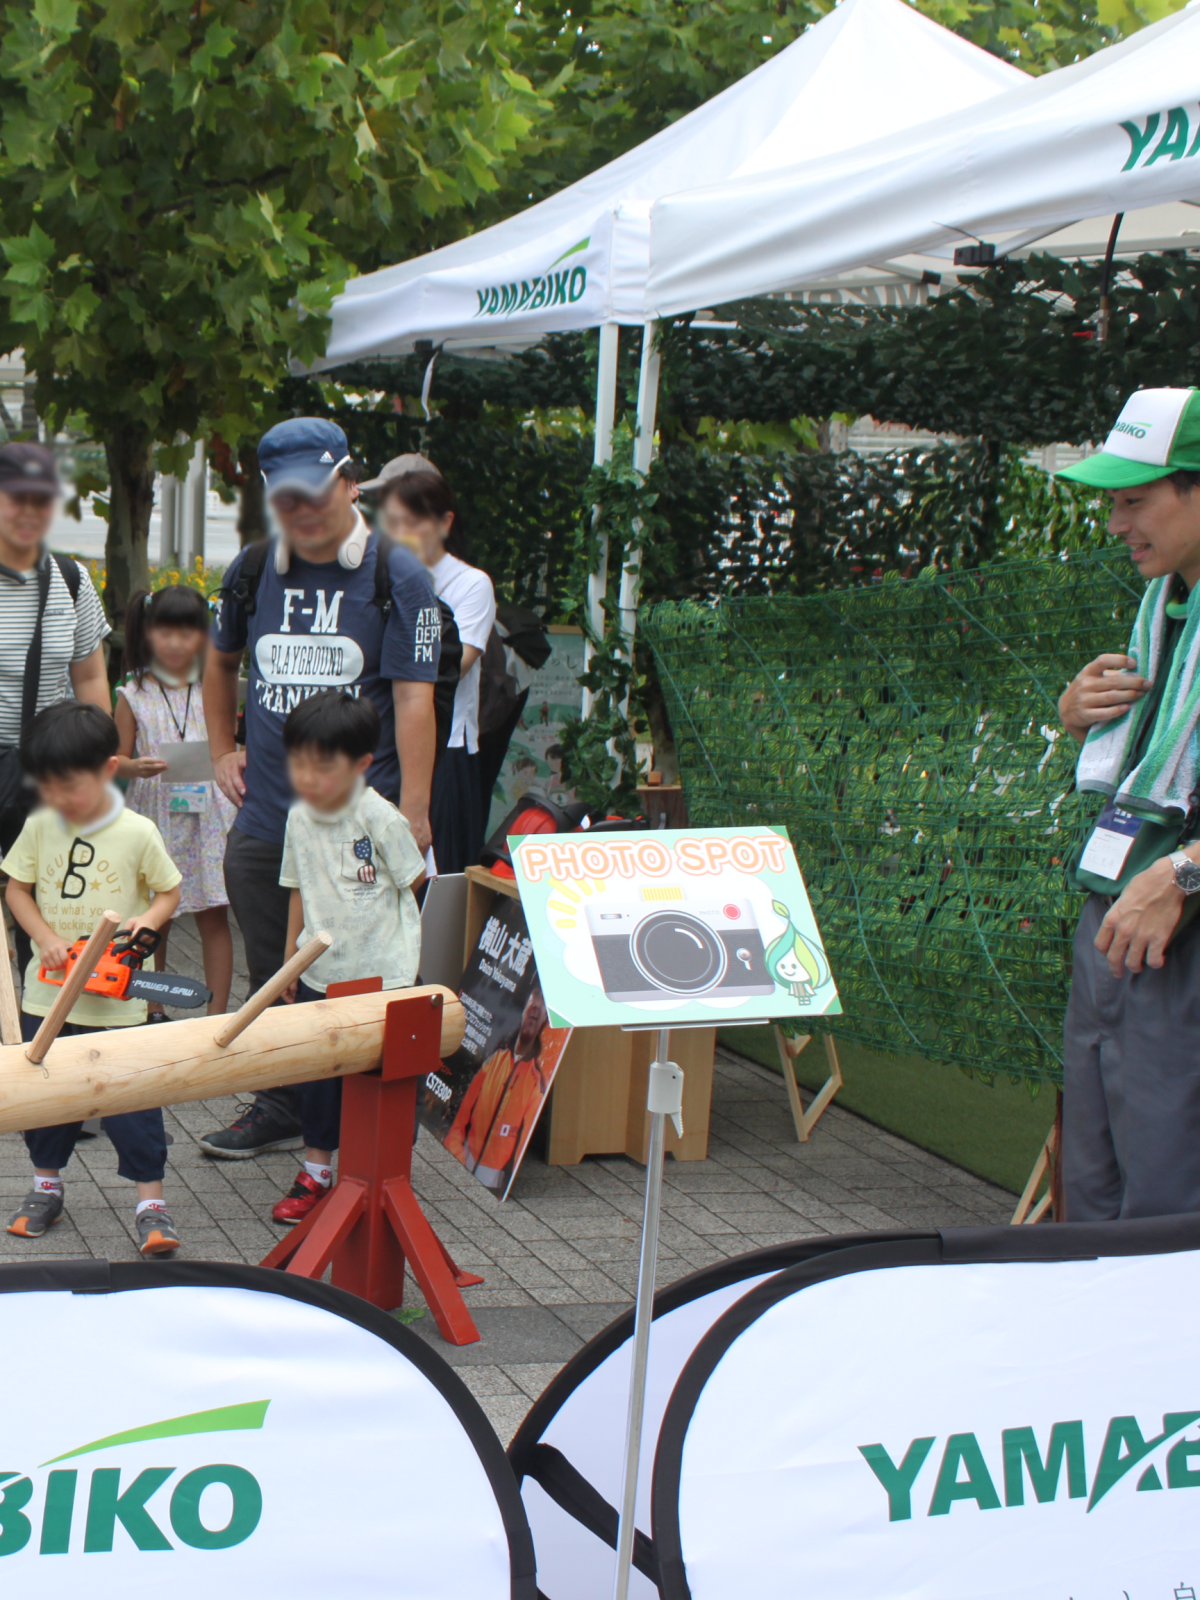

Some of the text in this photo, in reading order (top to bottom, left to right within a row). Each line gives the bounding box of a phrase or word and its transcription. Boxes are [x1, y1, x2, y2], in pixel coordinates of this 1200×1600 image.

[1118, 101, 1200, 173] YA
[473, 265, 587, 322] YAMABIKO
[280, 588, 345, 634] F-M
[271, 644, 344, 677] PLAYGROUND
[415, 644, 433, 663] FM
[96, 859, 122, 894] OUT
[520, 835, 788, 883] PHOTO SPOT
[61, 903, 85, 916] what
[89, 906, 108, 918] yo
[133, 979, 195, 997] POWER SAW
